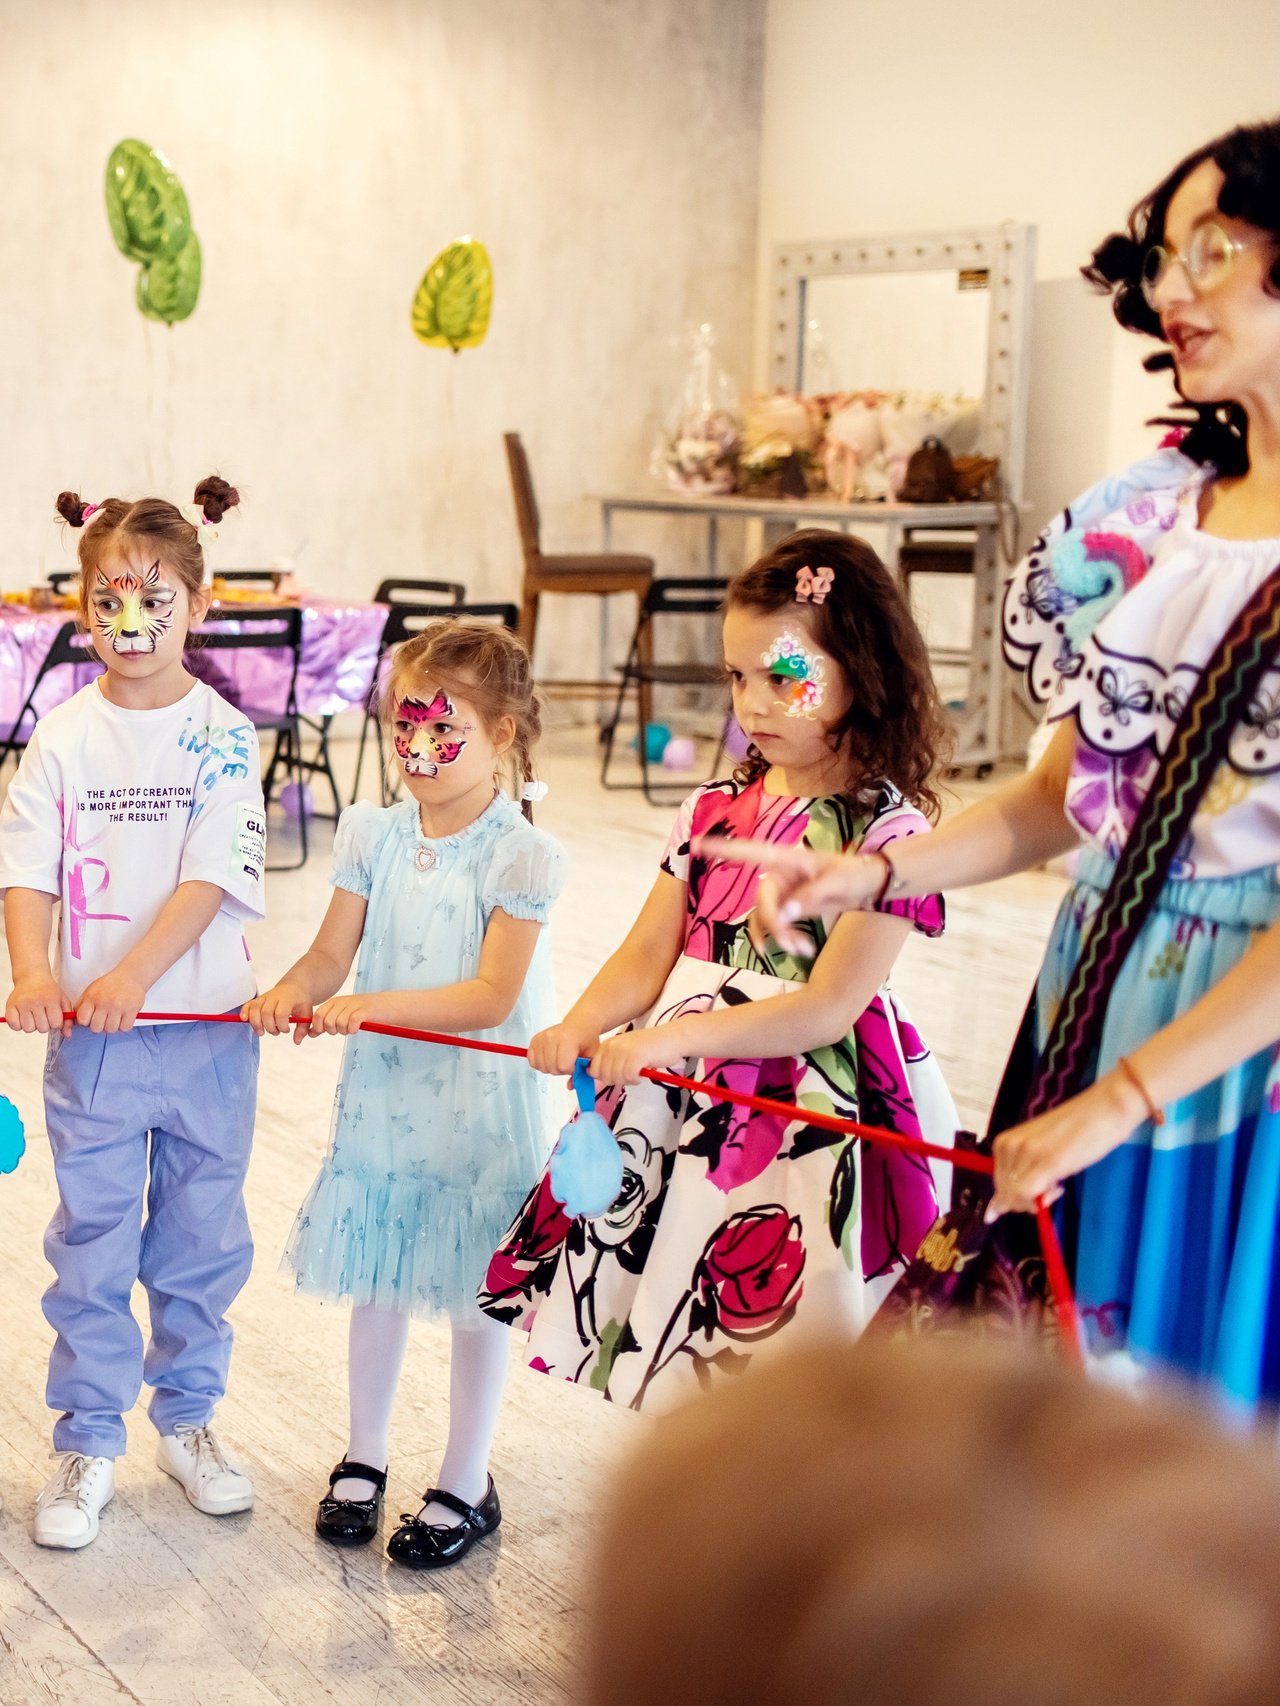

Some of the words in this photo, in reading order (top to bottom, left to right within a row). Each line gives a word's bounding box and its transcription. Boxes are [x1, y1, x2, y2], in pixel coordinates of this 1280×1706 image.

[87, 790, 105, 799] THE
[109, 788, 127, 798] ACT
[128, 787, 141, 797] OF
[143, 787, 192, 797] CREATION
[77, 802, 86, 811] IS
[89, 802, 117, 811] MORE
[119, 800, 172, 809] IMPORTANT
[176, 799, 195, 808] THA
[109, 813, 124, 822] THE
[128, 812, 168, 822] RESULT!
[246, 819, 265, 837] GL
